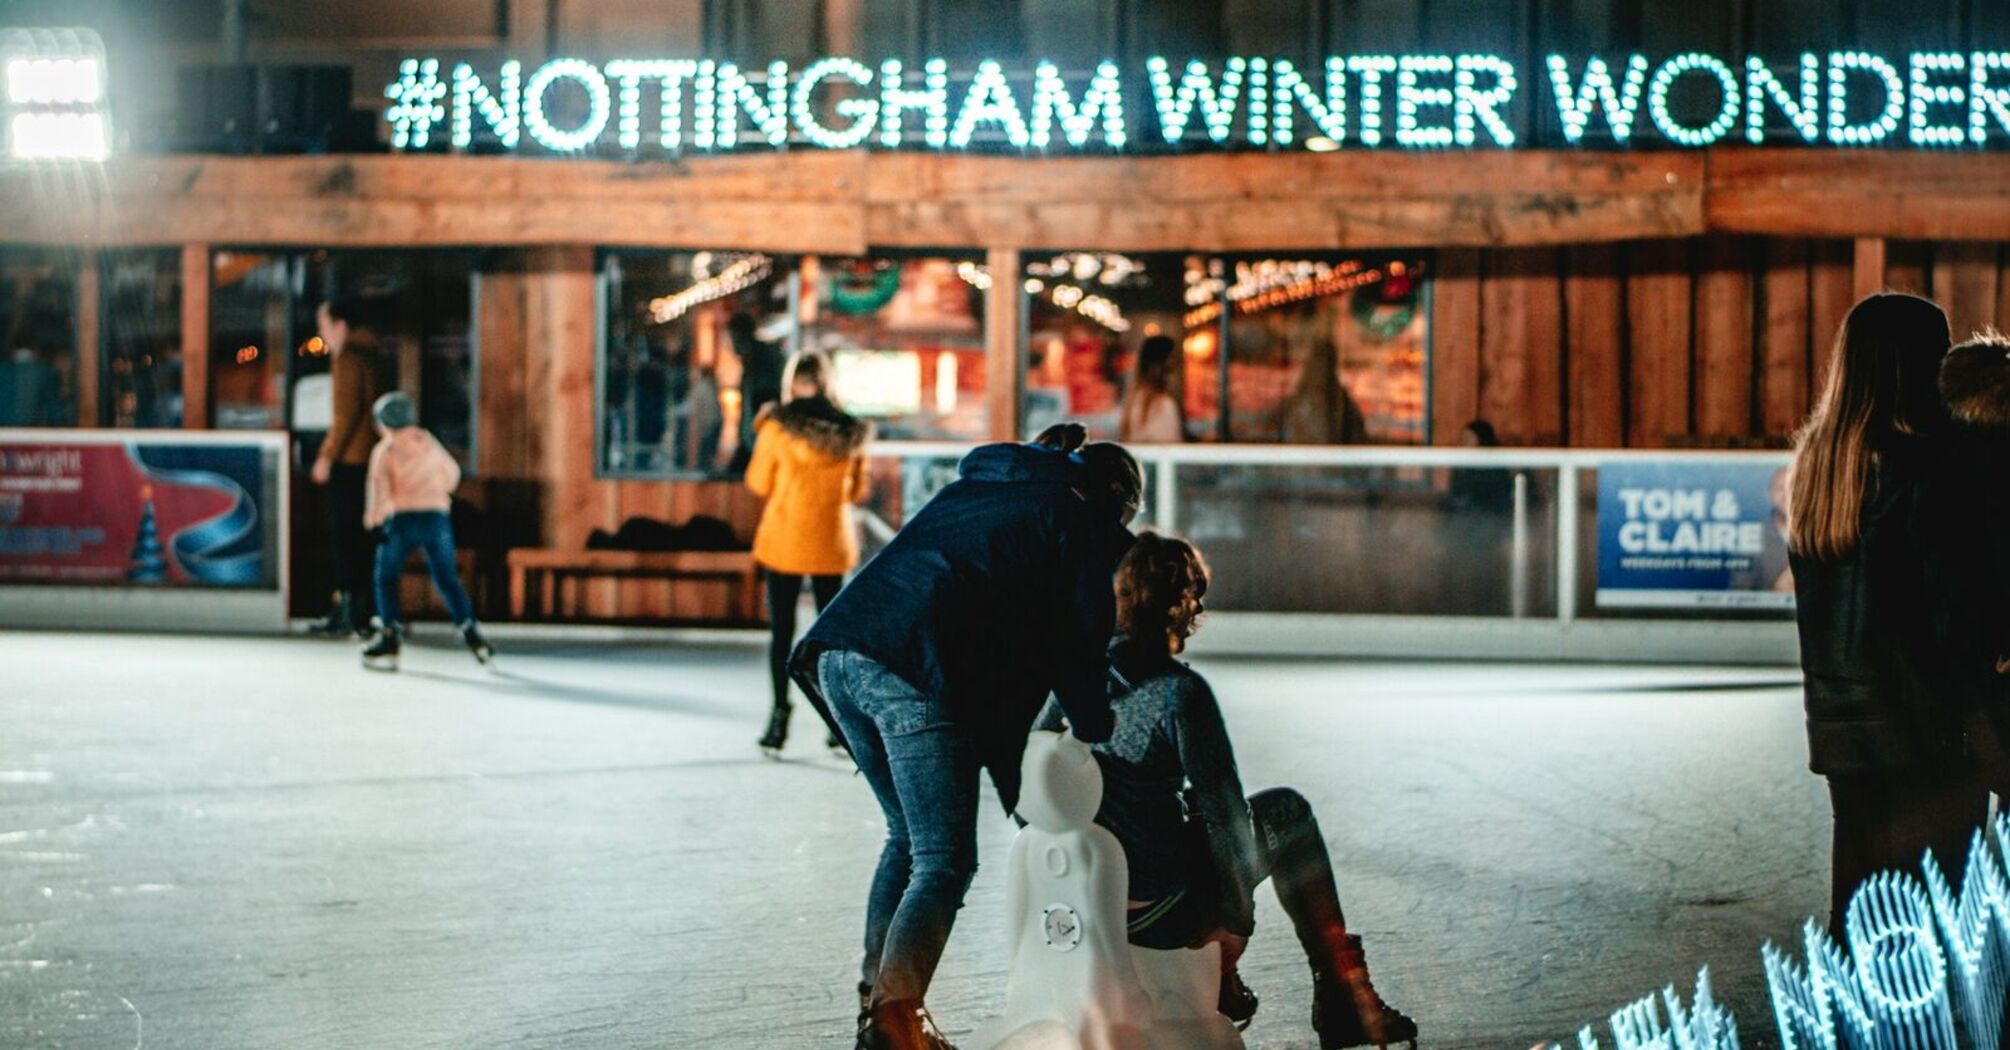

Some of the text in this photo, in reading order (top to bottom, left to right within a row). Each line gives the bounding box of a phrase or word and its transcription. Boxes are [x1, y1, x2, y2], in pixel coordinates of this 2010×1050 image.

[385, 56, 1125, 150] #NOTTINGHAM
[1147, 54, 1517, 147] WINTER
[1619, 489, 1739, 520] TOM &
[1618, 521, 1763, 553] CLAIRE
